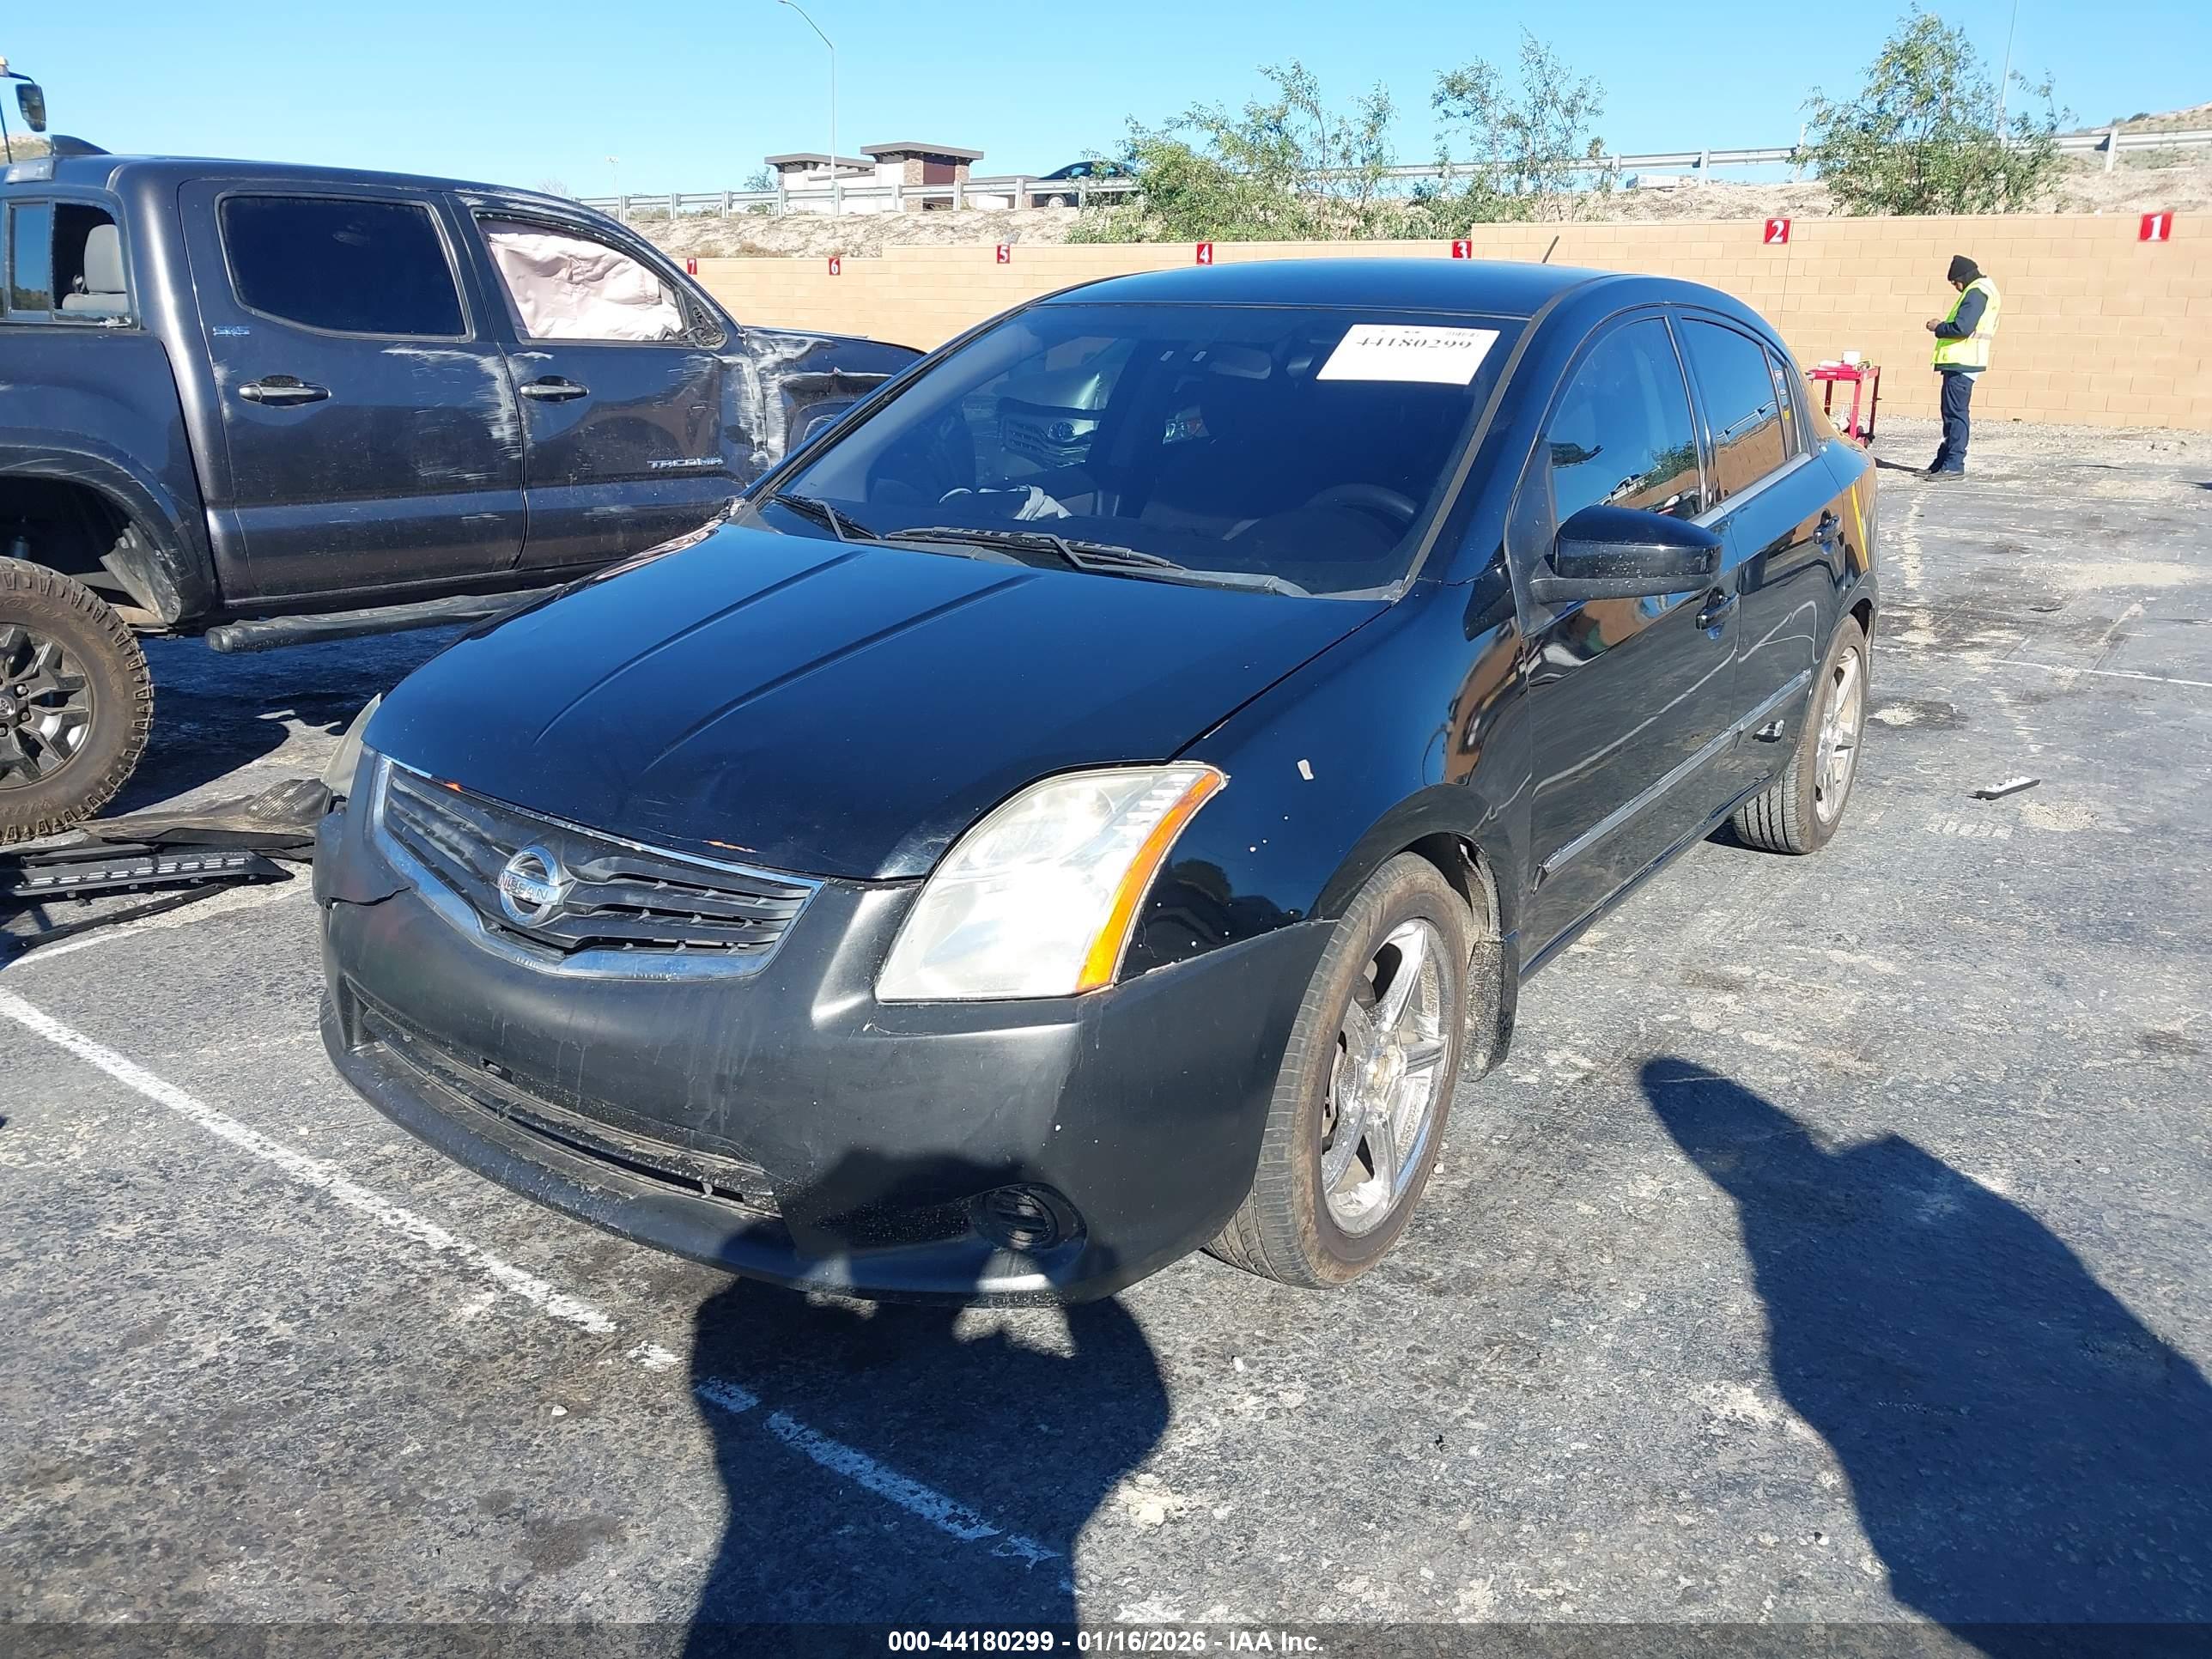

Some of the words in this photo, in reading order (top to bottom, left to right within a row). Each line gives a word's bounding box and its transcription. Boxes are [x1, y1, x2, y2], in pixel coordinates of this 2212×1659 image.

[1769, 220, 1785, 243] 2
[2150, 215, 2163, 240] 1
[1000, 246, 1008, 263] 5
[1199, 244, 1210, 263] 4
[1457, 241, 1468, 260] 3
[688, 259, 696, 274] 7
[830, 258, 839, 274] 6
[1356, 337, 1473, 349] 44180299
[647, 458, 724, 469] TACOMA
[499, 872, 549, 901] NISSAN
